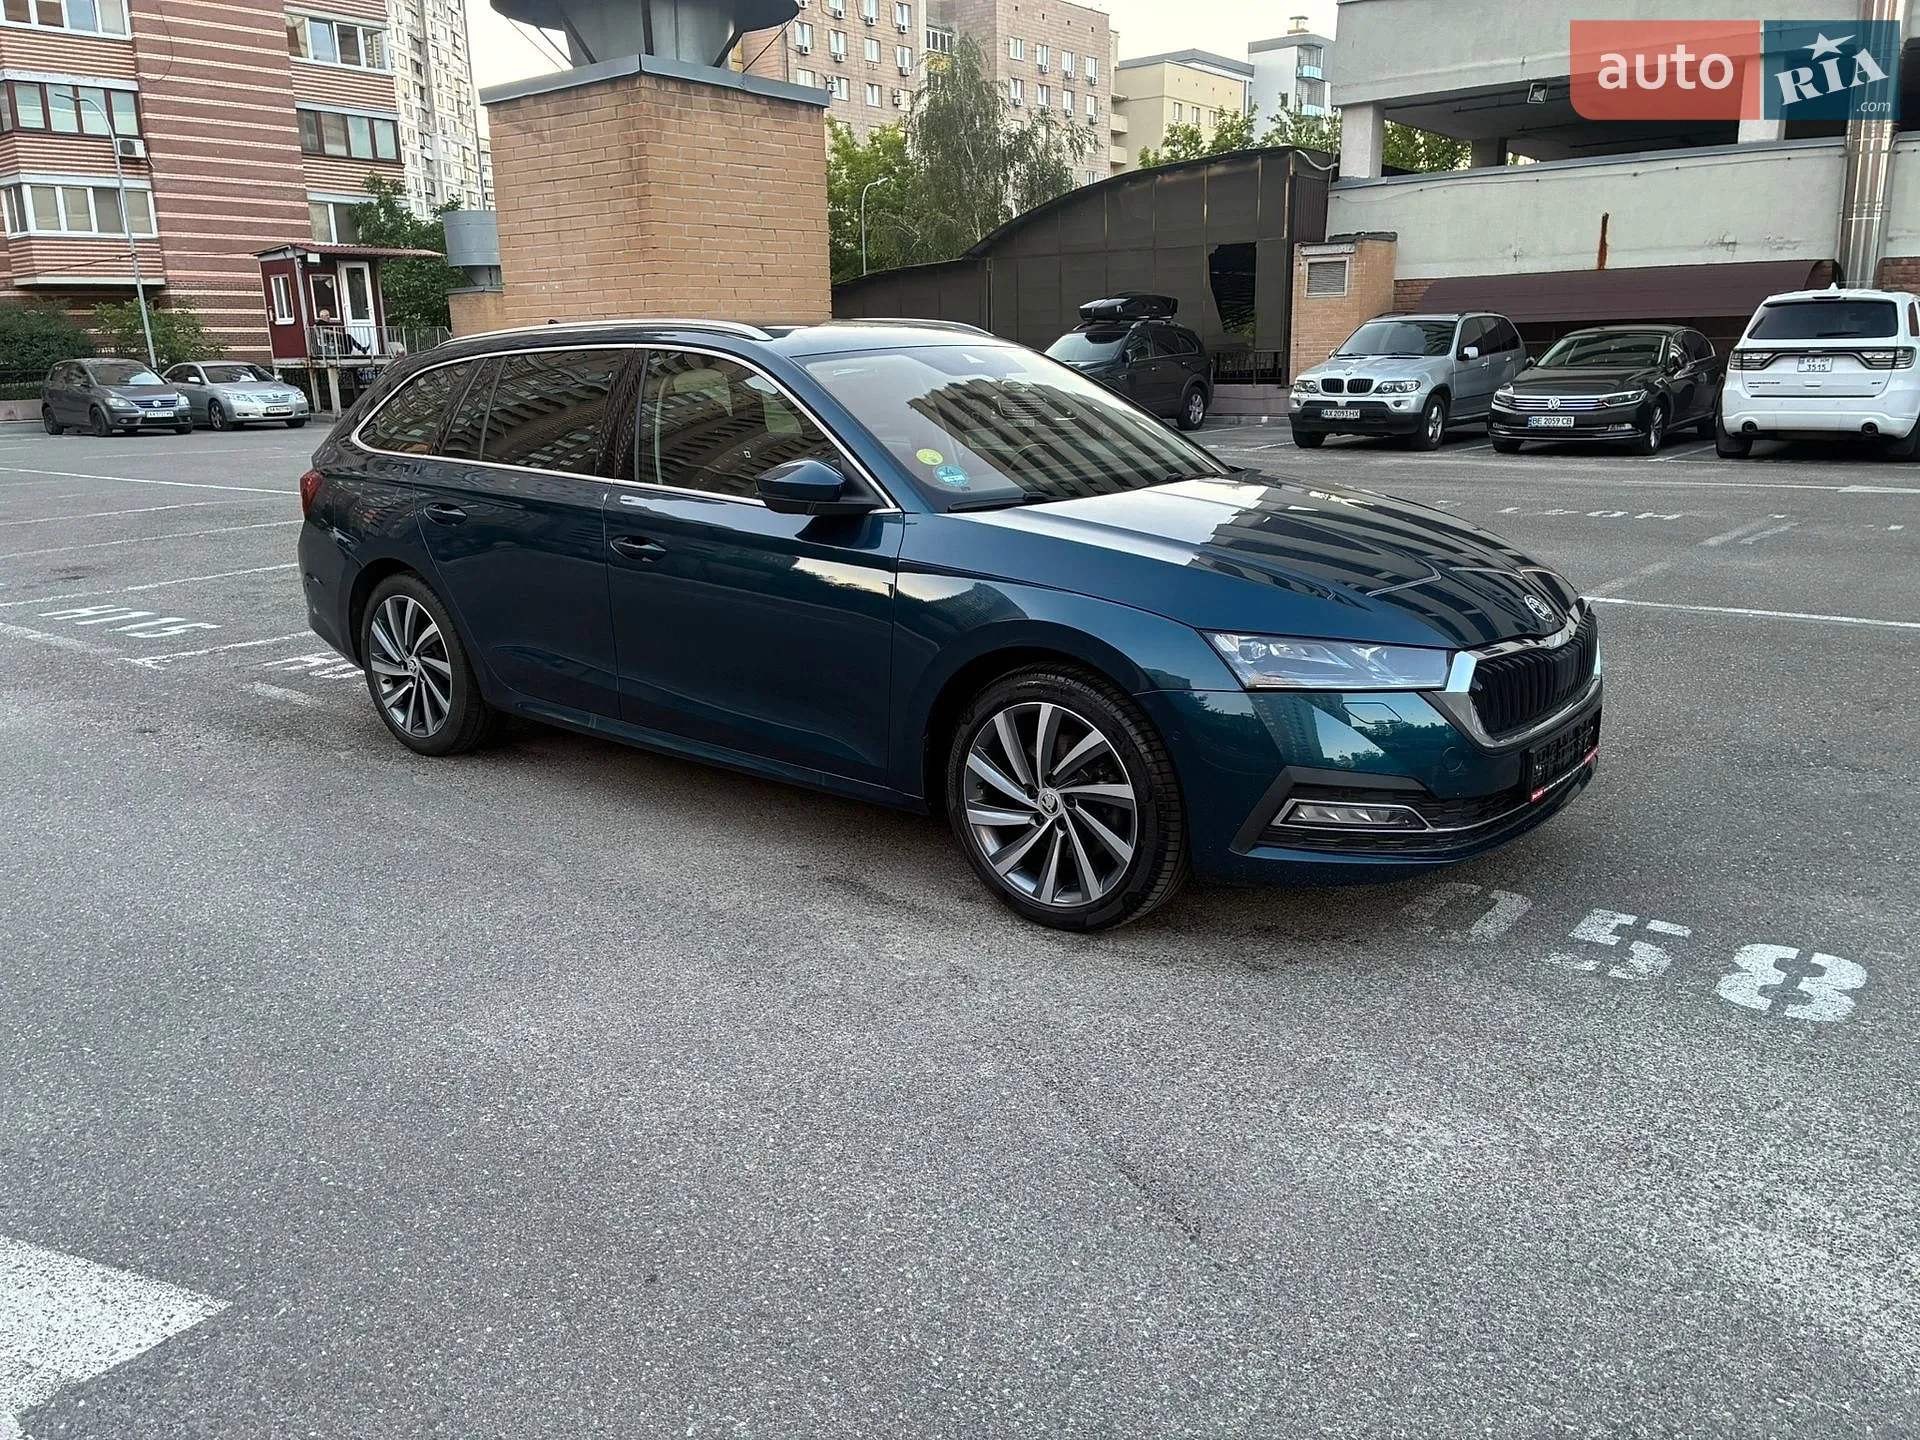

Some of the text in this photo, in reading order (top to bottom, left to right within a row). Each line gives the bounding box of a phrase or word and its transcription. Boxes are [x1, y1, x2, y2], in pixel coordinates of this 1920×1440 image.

[1532, 417, 1572, 425] BE 2059 CB
